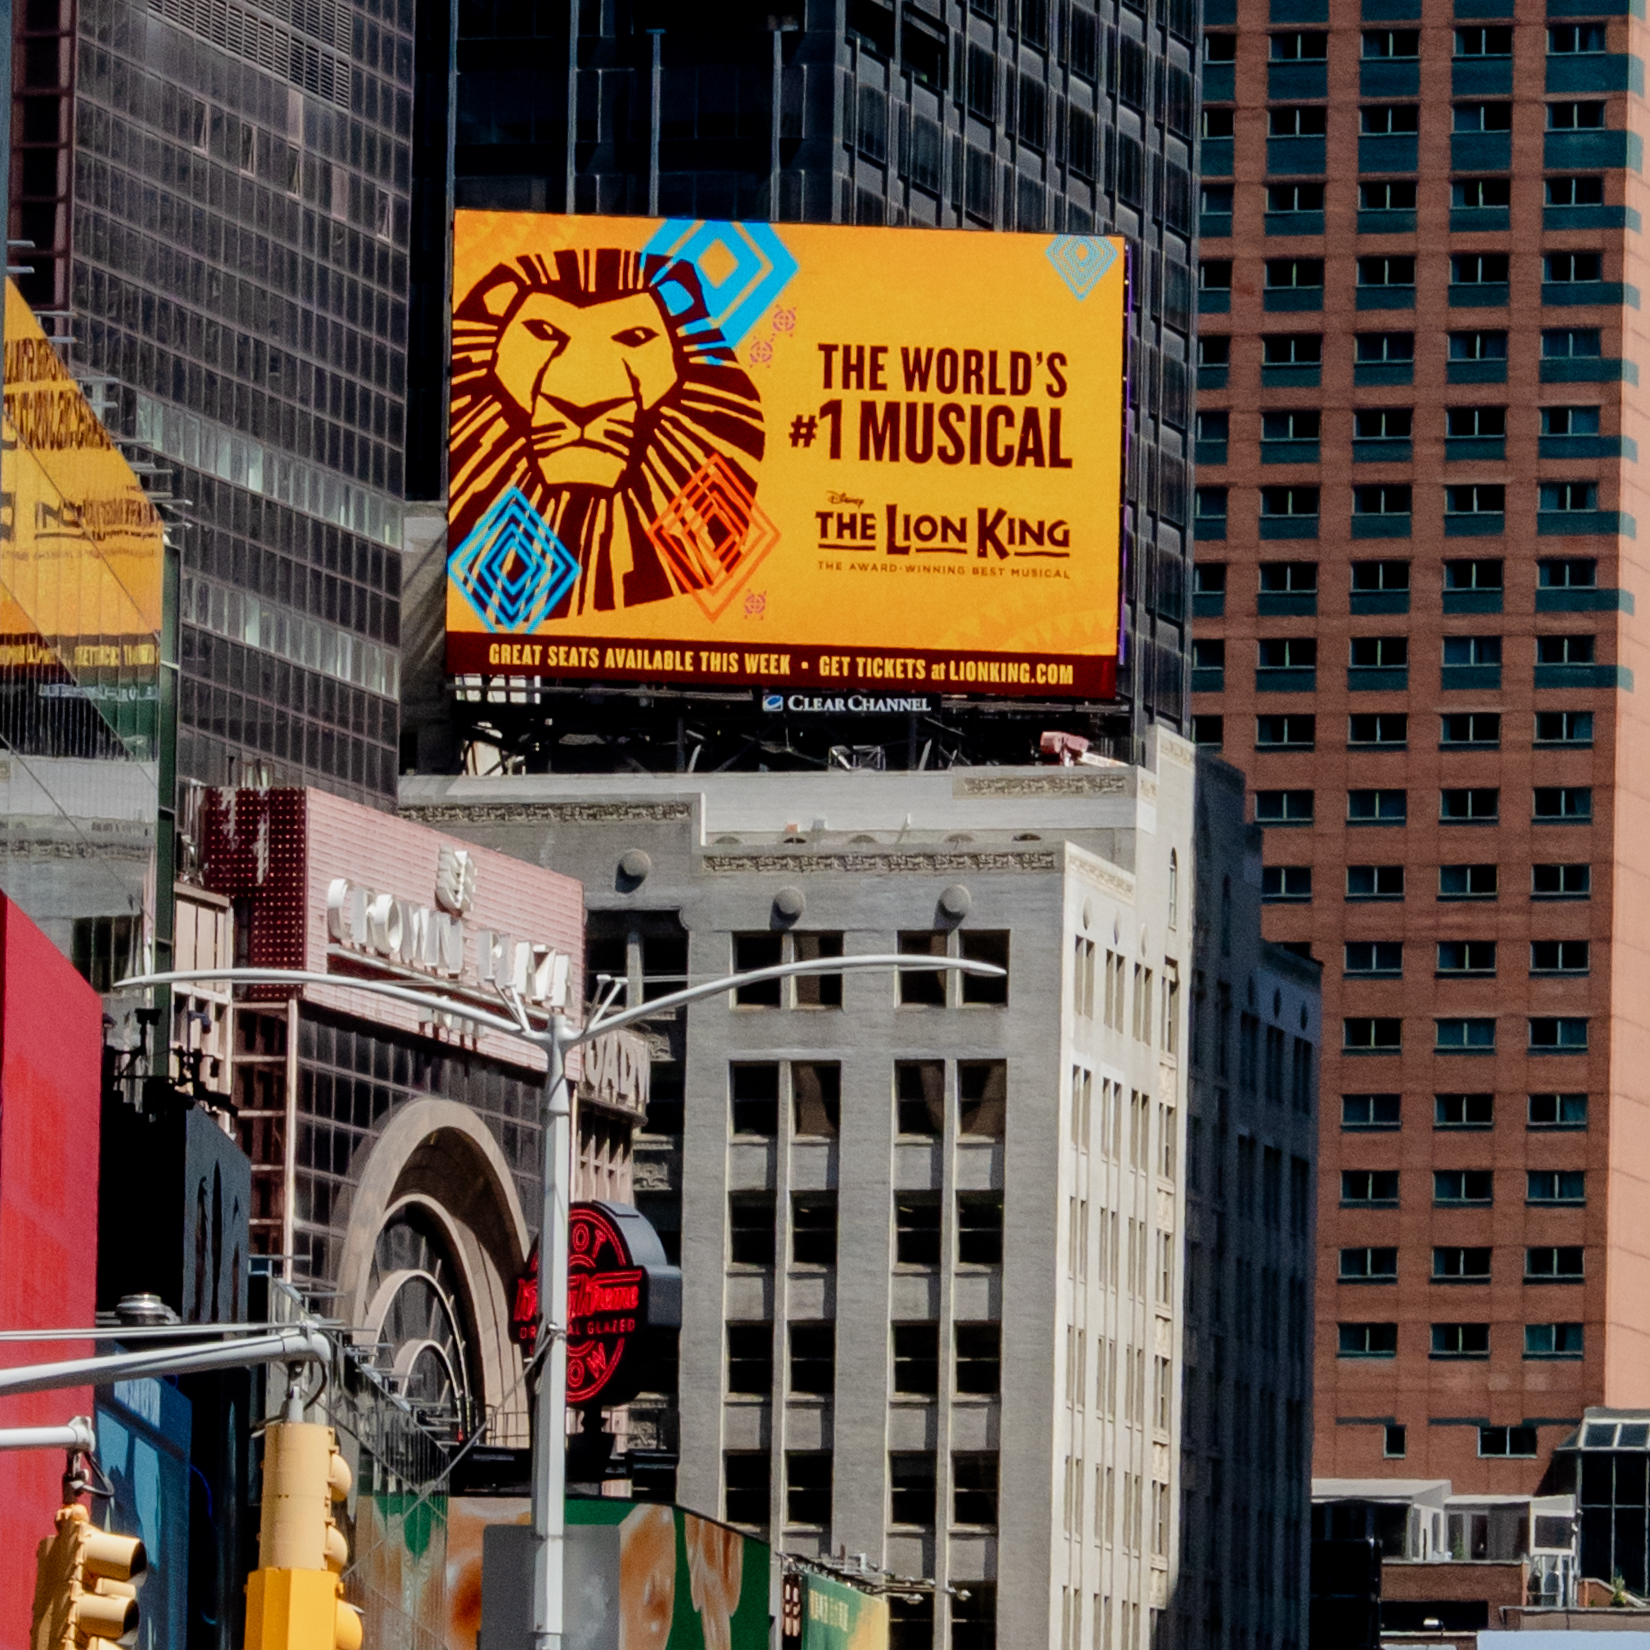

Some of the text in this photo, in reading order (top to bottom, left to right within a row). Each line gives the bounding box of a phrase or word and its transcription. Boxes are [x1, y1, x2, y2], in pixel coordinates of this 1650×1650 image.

[817, 343, 1068, 398] THE WORLD'S
[789, 400, 1072, 468] #1 MUSICAL
[816, 511, 877, 549] THE
[818, 560, 1071, 580] THE AWARD-WINNING BEST MUSICAL
[489, 644, 1073, 684] GREAT SEATS AVAILABLE THIS WEEK GET TICKETS at LIONKING.COM
[787, 694, 932, 712] CLEAR CHANNEL
